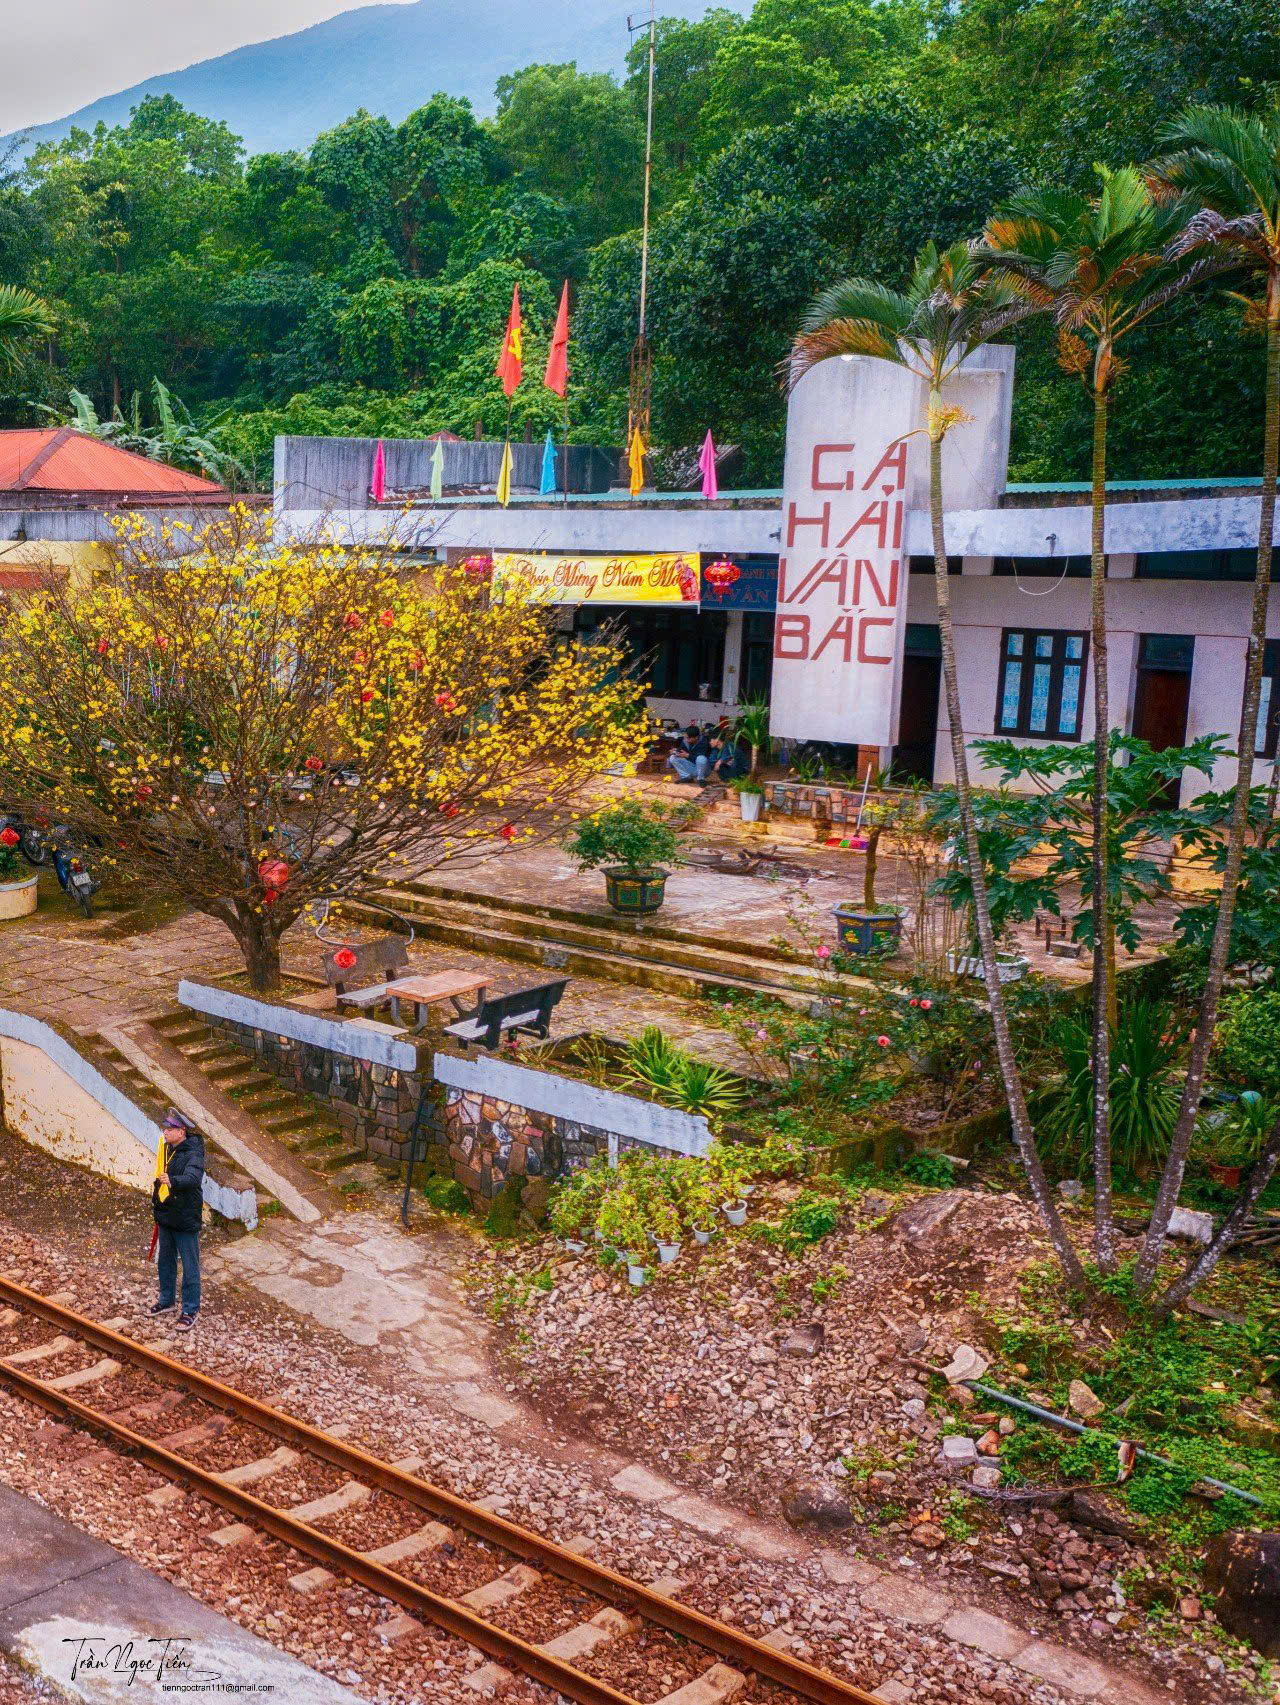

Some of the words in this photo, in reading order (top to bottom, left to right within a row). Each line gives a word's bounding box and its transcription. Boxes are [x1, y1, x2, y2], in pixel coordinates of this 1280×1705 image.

[811, 442, 907, 491] GA
[603, 559, 643, 587] Năm
[778, 553, 899, 607] VÂN
[775, 608, 895, 665] BẮC
